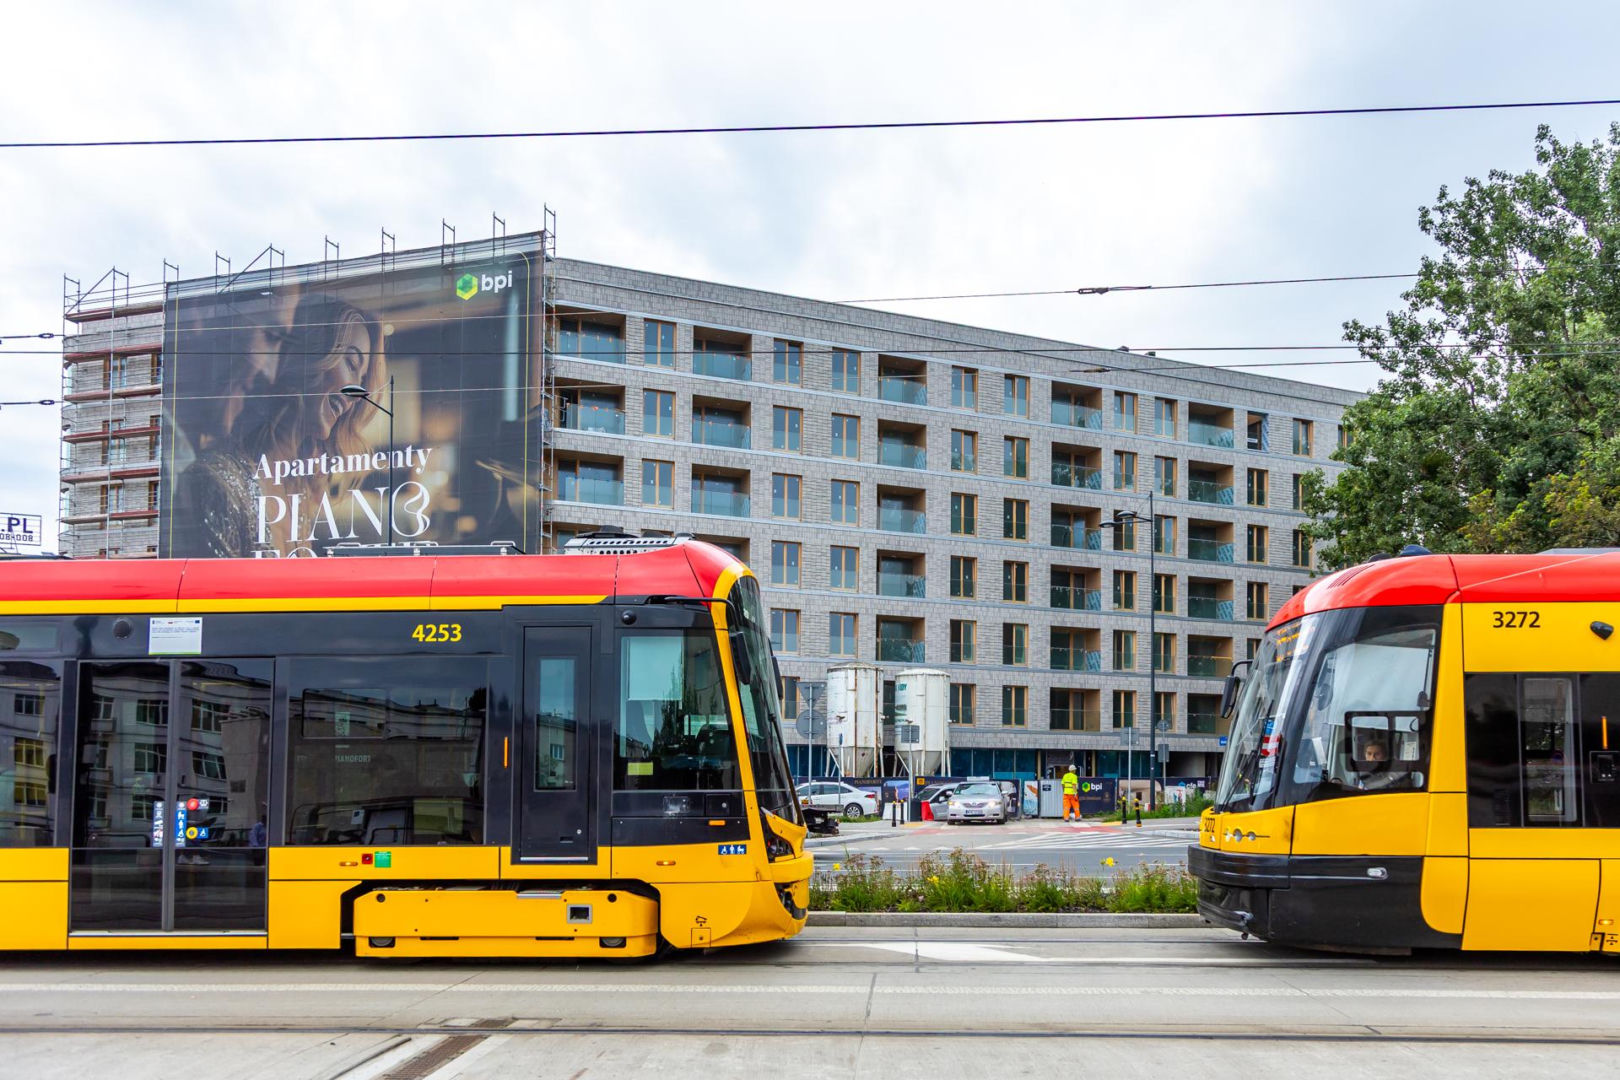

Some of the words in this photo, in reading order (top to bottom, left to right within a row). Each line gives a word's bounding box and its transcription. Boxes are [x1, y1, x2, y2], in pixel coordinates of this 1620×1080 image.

[481, 270, 513, 293] bpi
[253, 445, 432, 486] Apartamenty
[254, 481, 431, 544] PIANO
[1492, 610, 1541, 628] 3272
[411, 623, 462, 642] 4253
[1090, 782, 1103, 791] bpi
